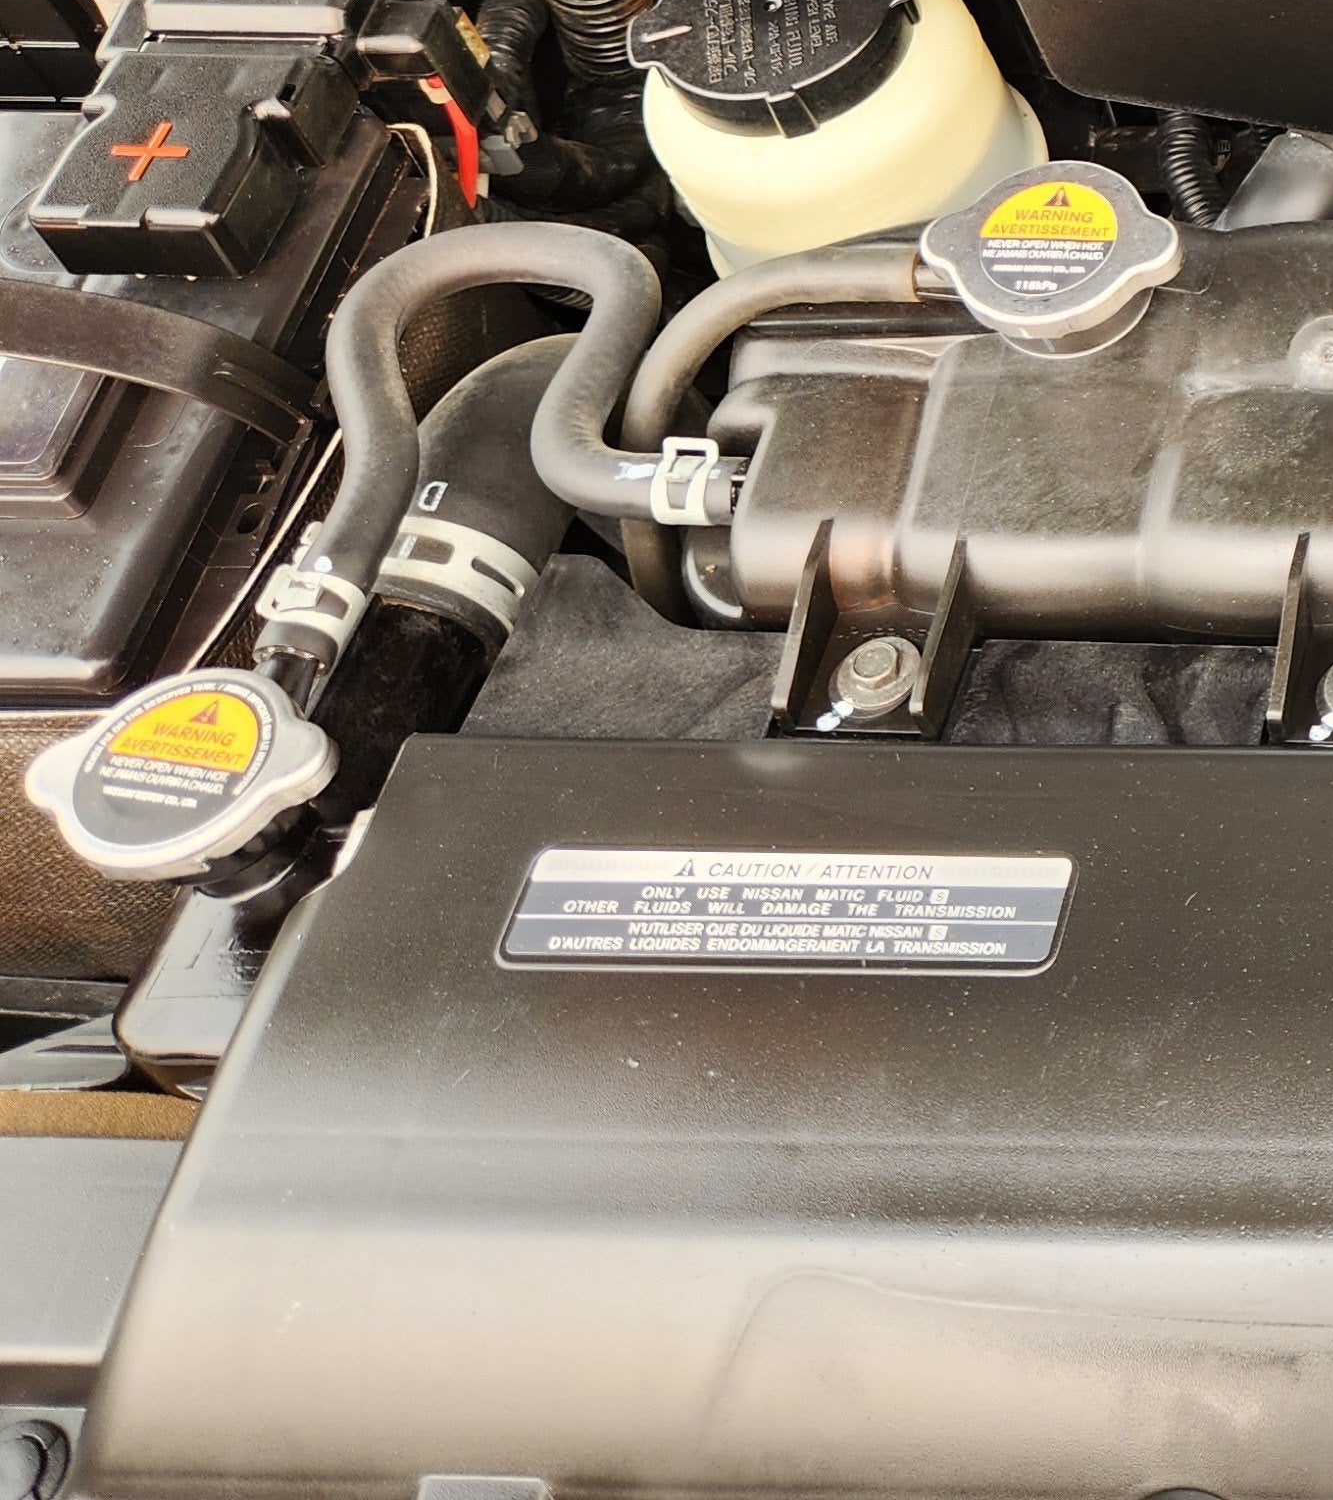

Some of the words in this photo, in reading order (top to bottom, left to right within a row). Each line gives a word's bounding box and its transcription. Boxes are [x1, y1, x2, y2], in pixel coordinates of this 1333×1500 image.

[1015, 210, 1094, 223] WARNING
[990, 224, 1110, 237] AVERTISSEMENT
[988, 240, 1021, 249] NEVER
[1021, 240, 1049, 250] OPEN
[1050, 240, 1081, 250] WHEN
[153, 722, 237, 748] WARNING
[120, 737, 245, 766] AVERTISSEMENT
[110, 756, 146, 771] NEVER
[144, 760, 175, 775] OPEN
[174, 764, 207, 780] WHEN
[708, 862, 802, 878] CAUTION
[820, 865, 934, 880] ATTENTION
[641, 886, 686, 900] ONLY
[696, 887, 731, 900] USE
[742, 887, 804, 901] NISSAN
[815, 888, 866, 902] MATIC
[877, 889, 924, 903] FLUID
[563, 900, 619, 914] OTHER
[633, 901, 692, 915] FLUIDS
[708, 902, 745, 915] WILL
[761, 902, 832, 917] DAMAGE
[847, 903, 879, 917] THE
[895, 905, 1017, 920] TRANSMISSION
[628, 922, 704, 936] N'UTILISER
[706, 923, 738, 937] QUE
[739, 924, 763, 937] DU
[764, 924, 822, 938] LIQUIDE
[822, 925, 867, 938] MATIC
[869, 926, 924, 939] NISSAN
[548, 936, 624, 950] D'AUTRES
[629, 937, 702, 951] LIQUIDES
[706, 938, 862, 954] ENDOMMAGERAIENT
[866, 940, 885, 954] LA
[894, 941, 1008, 956] TRANSMISSION
